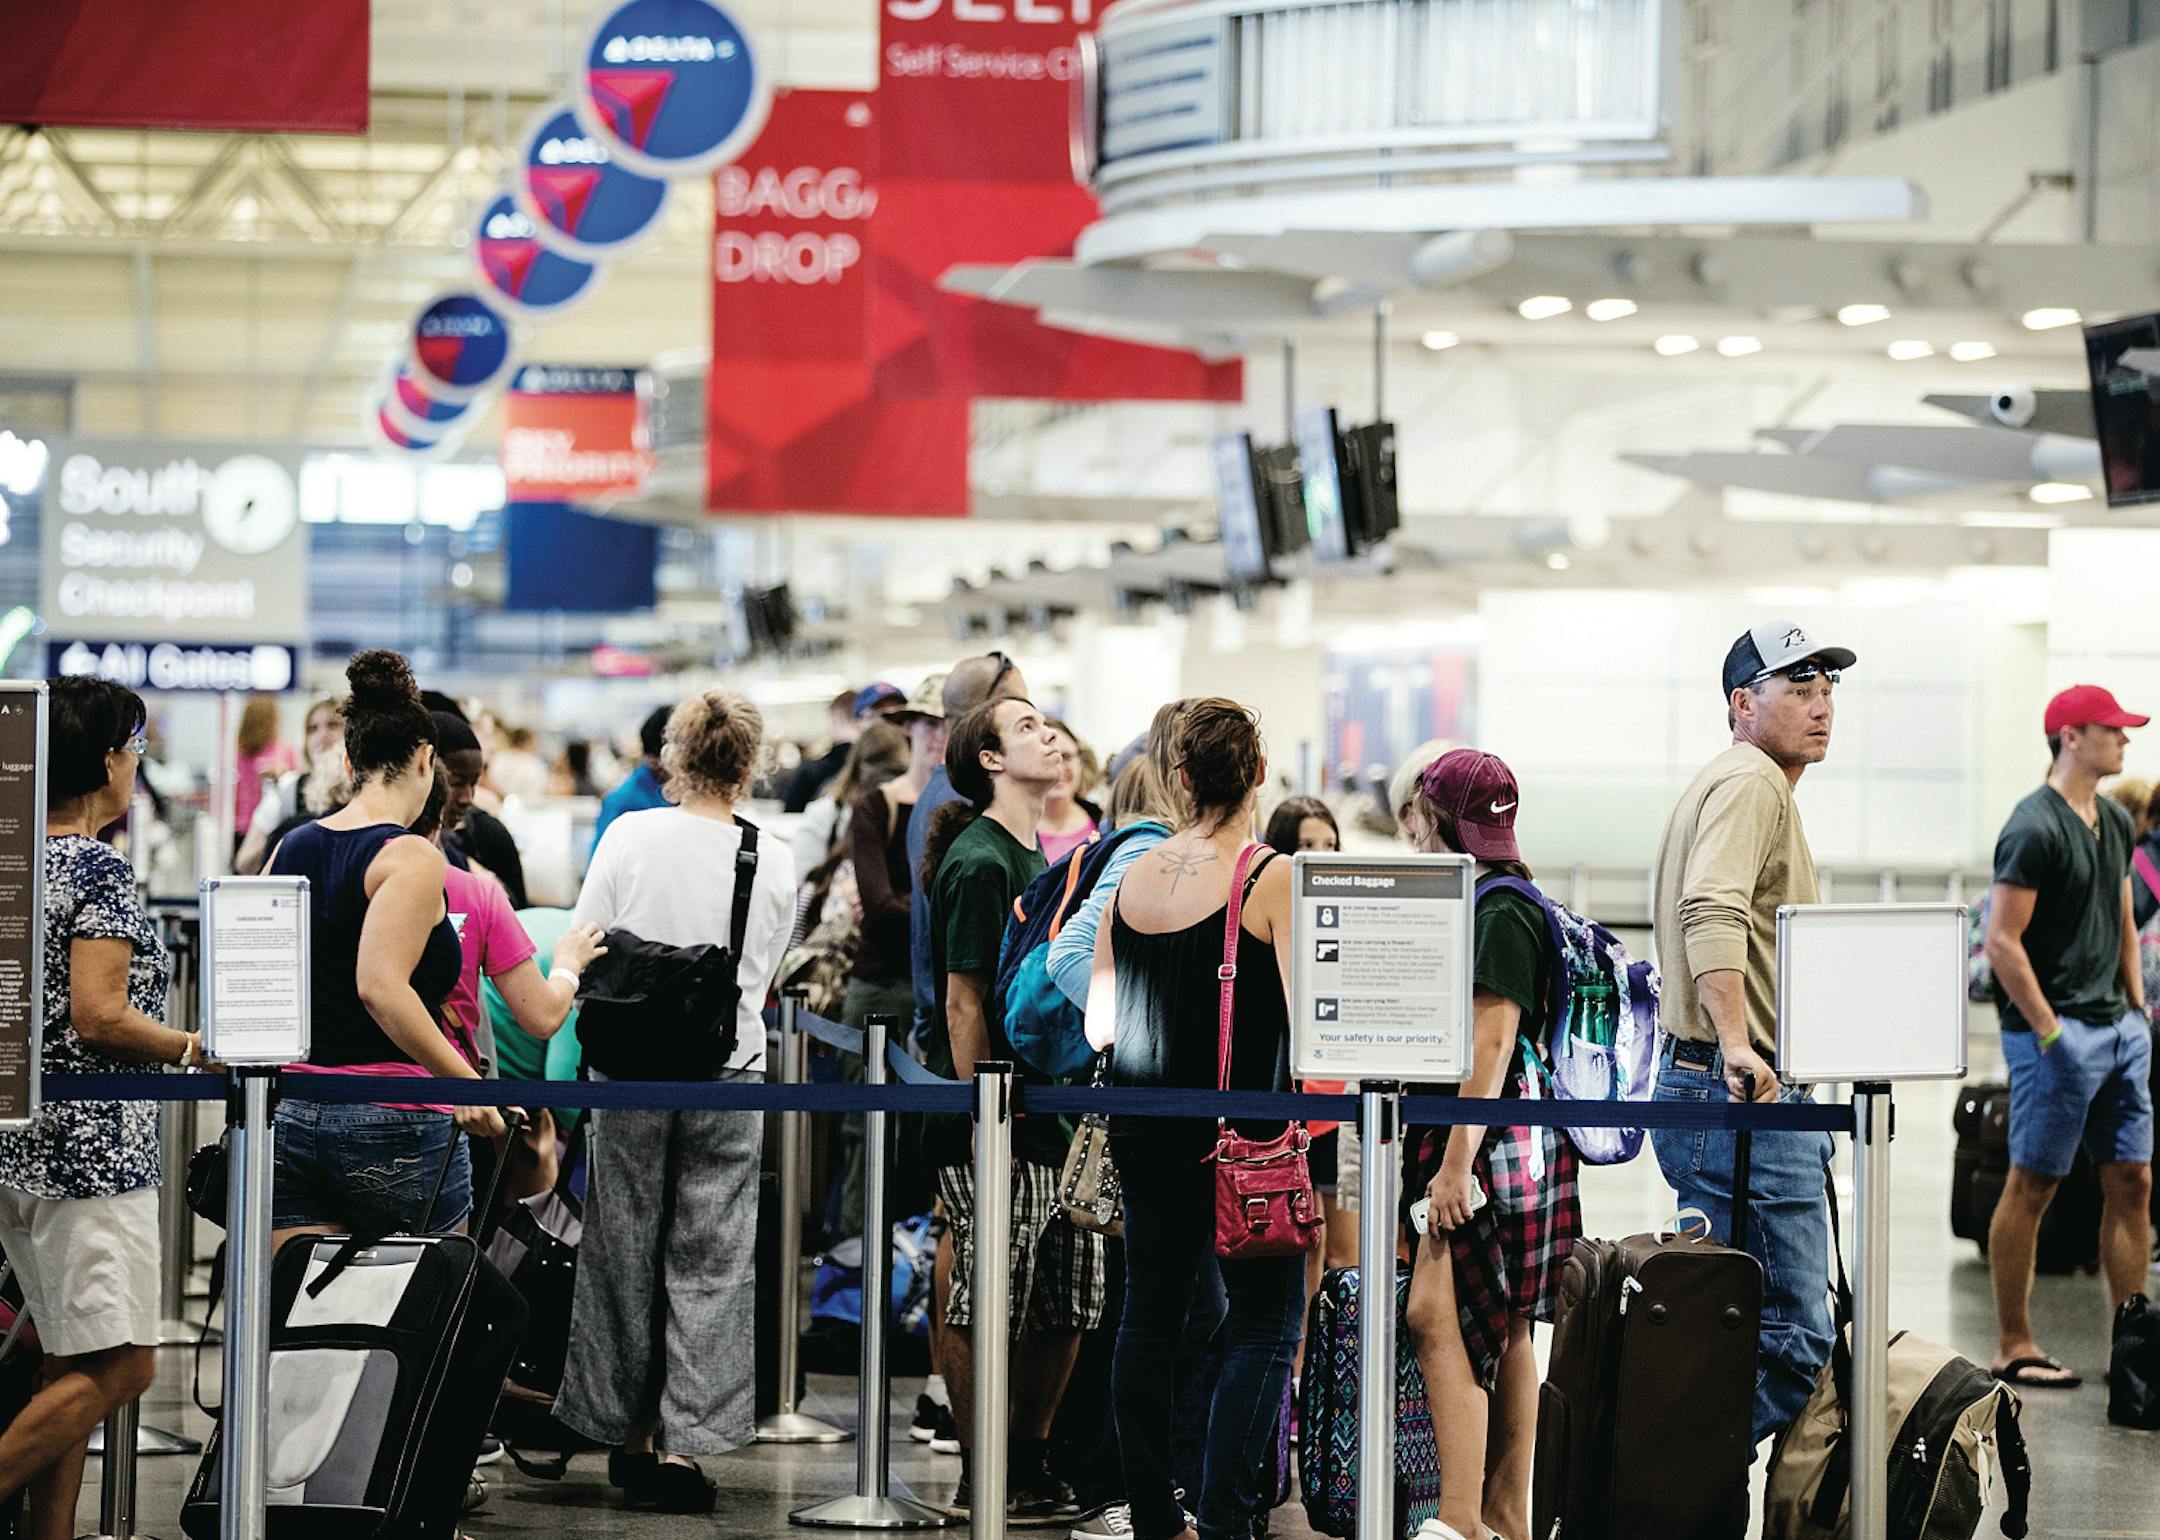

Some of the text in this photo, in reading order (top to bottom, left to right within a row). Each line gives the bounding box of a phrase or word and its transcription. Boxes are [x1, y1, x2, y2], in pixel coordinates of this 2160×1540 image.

[886, 42, 942, 77] Self
[943, 43, 1046, 80] Service
[715, 230, 861, 285] DROP
[60, 453, 213, 515] South
[60, 521, 205, 575] Security
[59, 571, 254, 624] Checkpoint
[2, 762, 34, 772] luggage
[1312, 876, 1395, 888] Checked Baggage
[1320, 1034, 1341, 1042] Your
[1344, 1034, 1373, 1043] safety
[1376, 1034, 1384, 1042] is
[1406, 1034, 1442, 1044] priority
